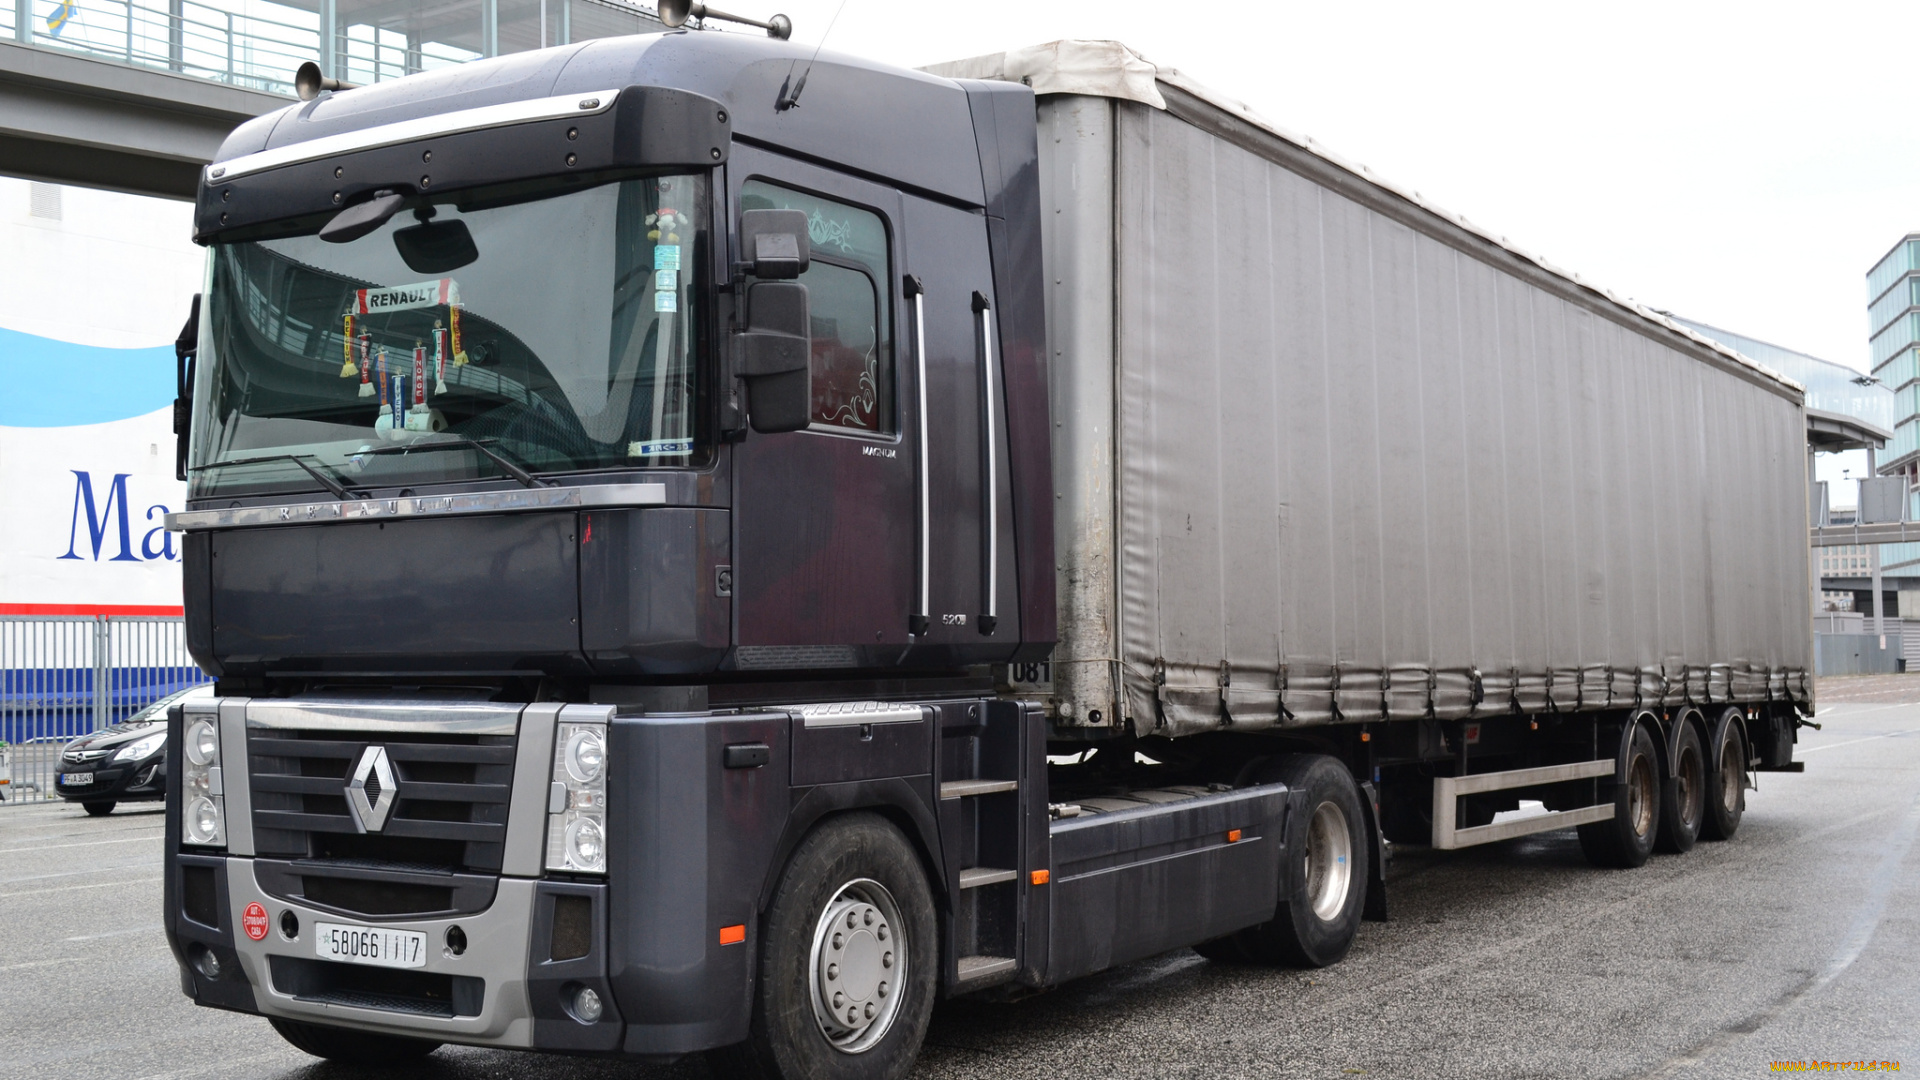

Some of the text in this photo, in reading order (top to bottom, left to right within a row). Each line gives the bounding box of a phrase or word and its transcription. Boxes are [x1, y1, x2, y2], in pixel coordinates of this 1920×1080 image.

[370, 287, 435, 308] RENAULT
[862, 445, 897, 460] MAGNUM
[56, 469, 183, 563] Ma
[279, 497, 454, 521] RENAULT
[942, 613, 961, 626] 520
[331, 929, 379, 958] 58066
